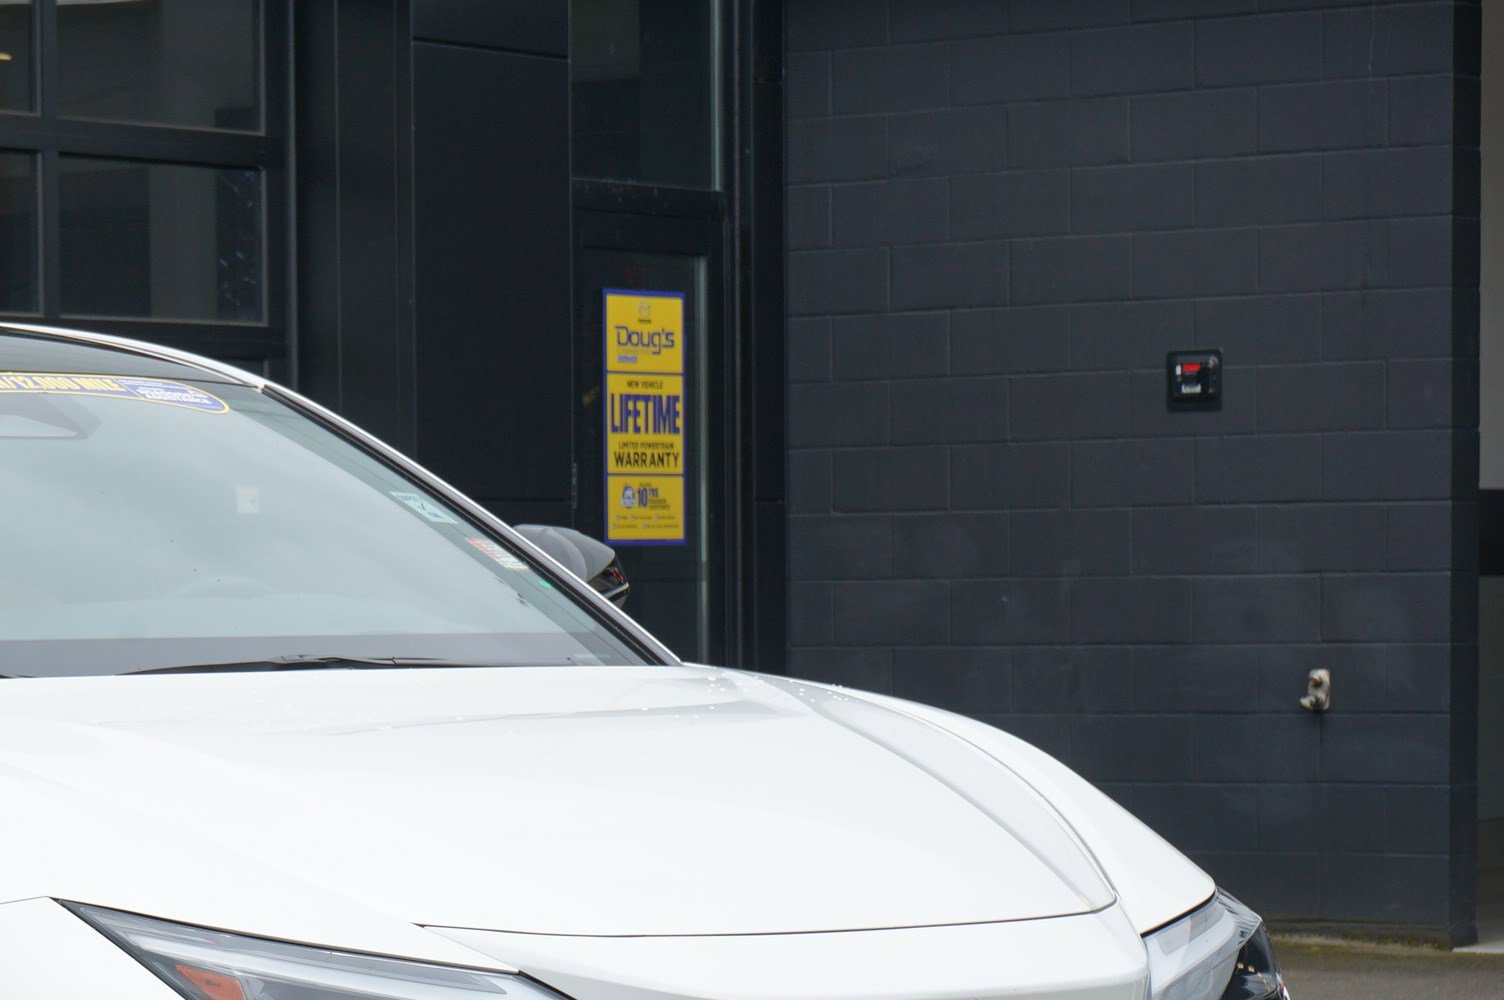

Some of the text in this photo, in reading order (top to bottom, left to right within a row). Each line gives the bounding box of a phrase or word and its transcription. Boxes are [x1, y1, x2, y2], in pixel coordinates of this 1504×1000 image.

[614, 325, 675, 355] Doug's
[610, 393, 680, 434] LIFETIME
[613, 451, 680, 469] WARRANTY
